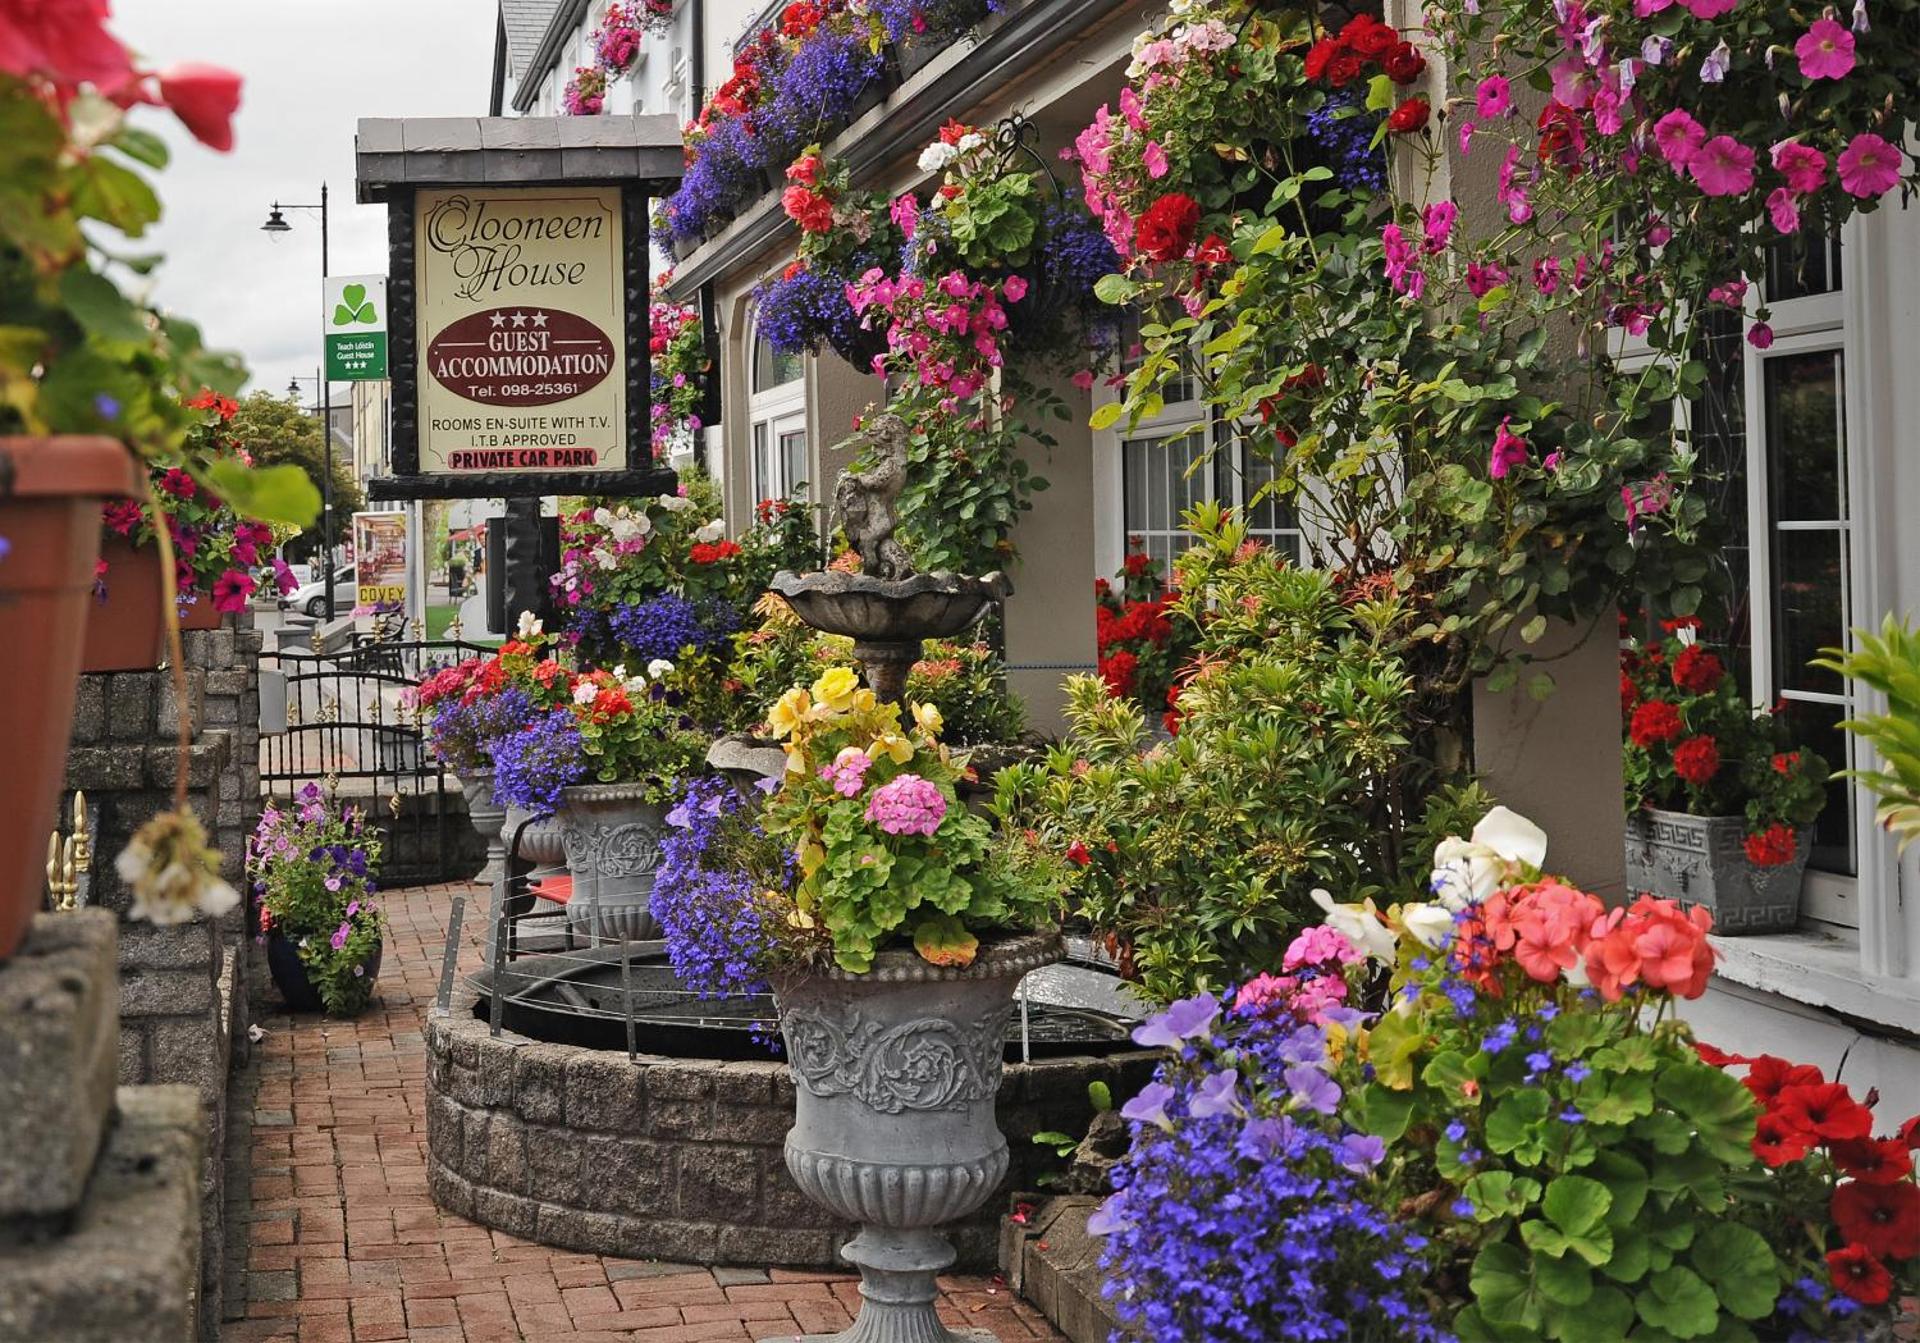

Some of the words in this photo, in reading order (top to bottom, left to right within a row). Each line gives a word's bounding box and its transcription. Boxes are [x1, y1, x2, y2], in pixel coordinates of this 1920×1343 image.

[428, 194, 603, 257] Clooneen
[453, 244, 586, 302] House
[337, 342, 354, 350] Teach
[488, 331, 551, 352] GUEST
[337, 352, 354, 360] Guest
[355, 351, 374, 359] House
[436, 353, 609, 379] ACCOMMODATION
[468, 385, 497, 398] Tel.
[501, 383, 578, 397] 098-25361
[432, 418, 482, 431] ROOMS
[486, 417, 547, 431] EN-SUITE
[551, 416, 585, 429] WITH
[588, 416, 611, 429] T.V.
[471, 435, 498, 447] I.T.B
[502, 433, 577, 447] APPROVED
[452, 451, 514, 469] PRIVATE
[519, 450, 549, 467] CAR
[554, 449, 594, 466] PARK
